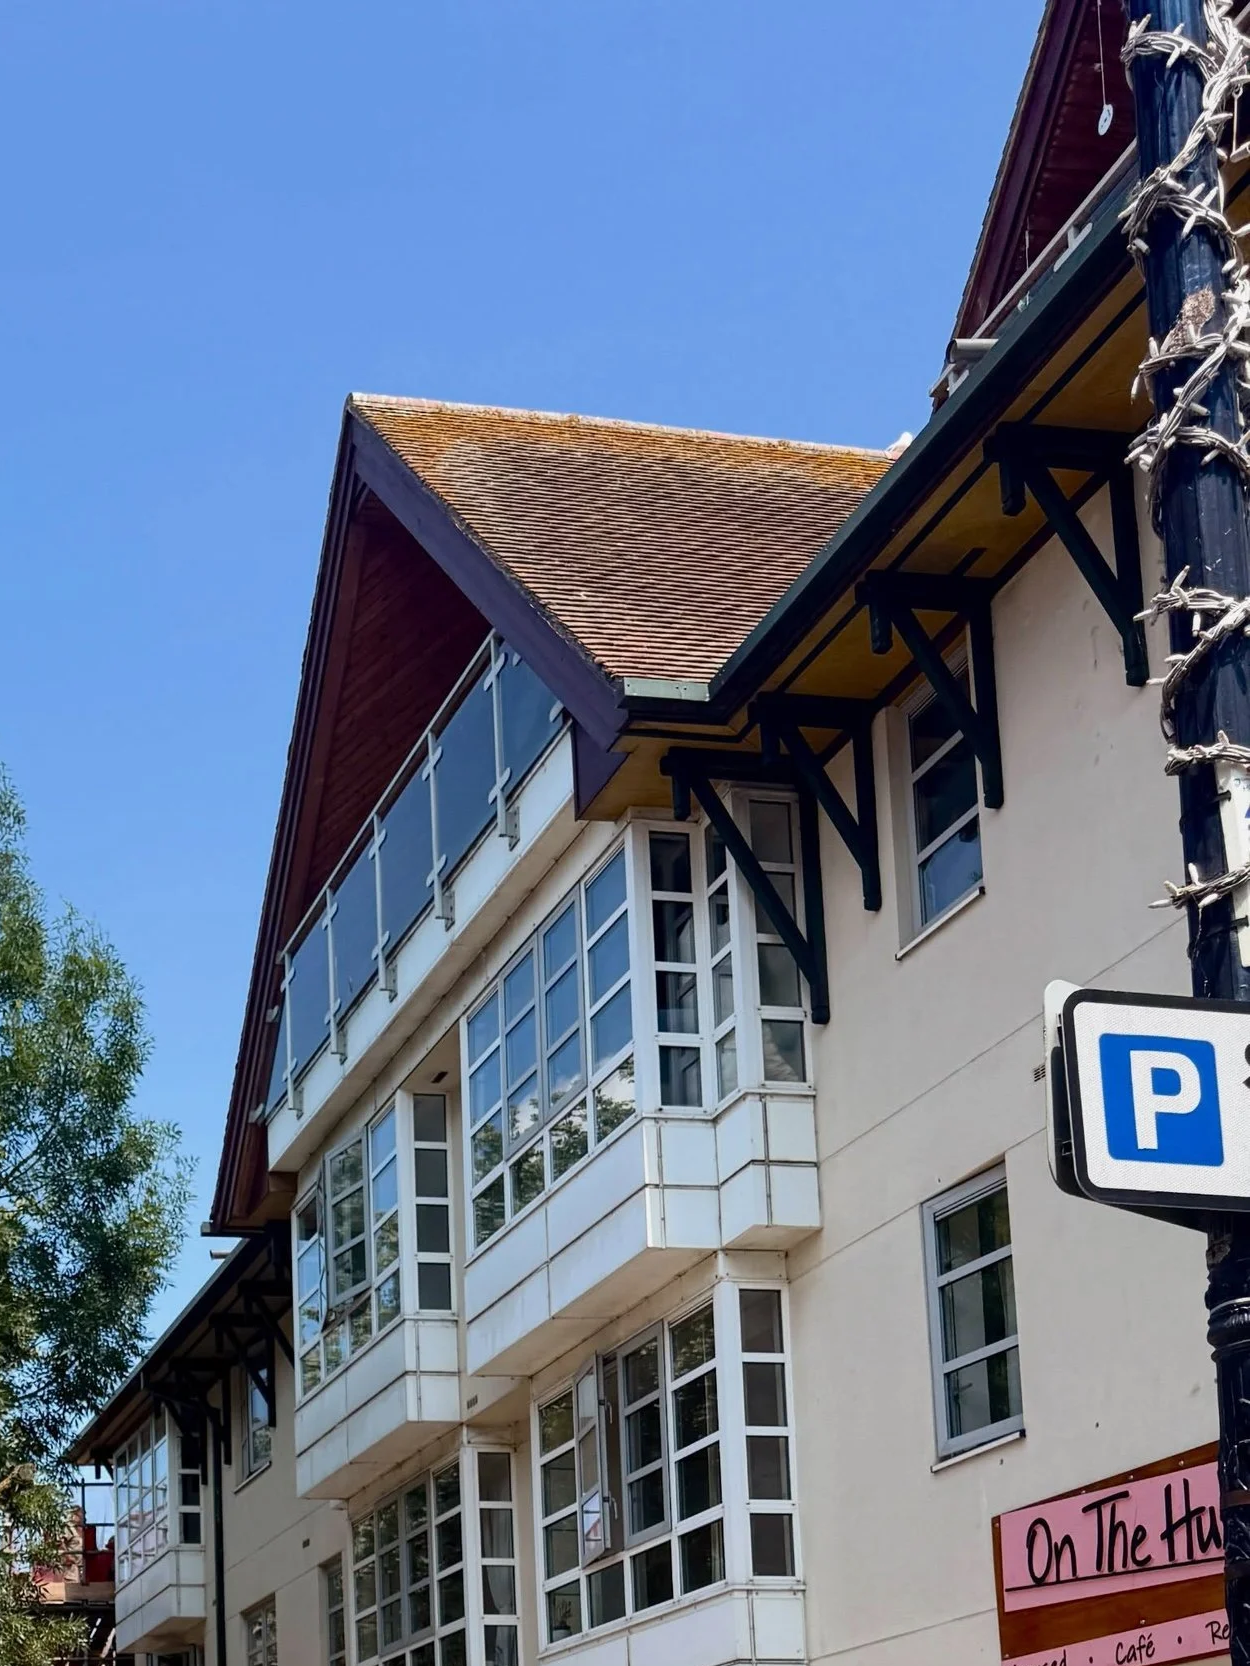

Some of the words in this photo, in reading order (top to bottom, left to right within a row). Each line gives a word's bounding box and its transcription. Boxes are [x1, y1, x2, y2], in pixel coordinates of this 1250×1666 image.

[1129, 1049, 1202, 1150] P
[1026, 1516, 1078, 1586] On
[1081, 1490, 1153, 1573] The
[1159, 1477, 1223, 1563] Hu
[1114, 1632, 1157, 1666] Café
